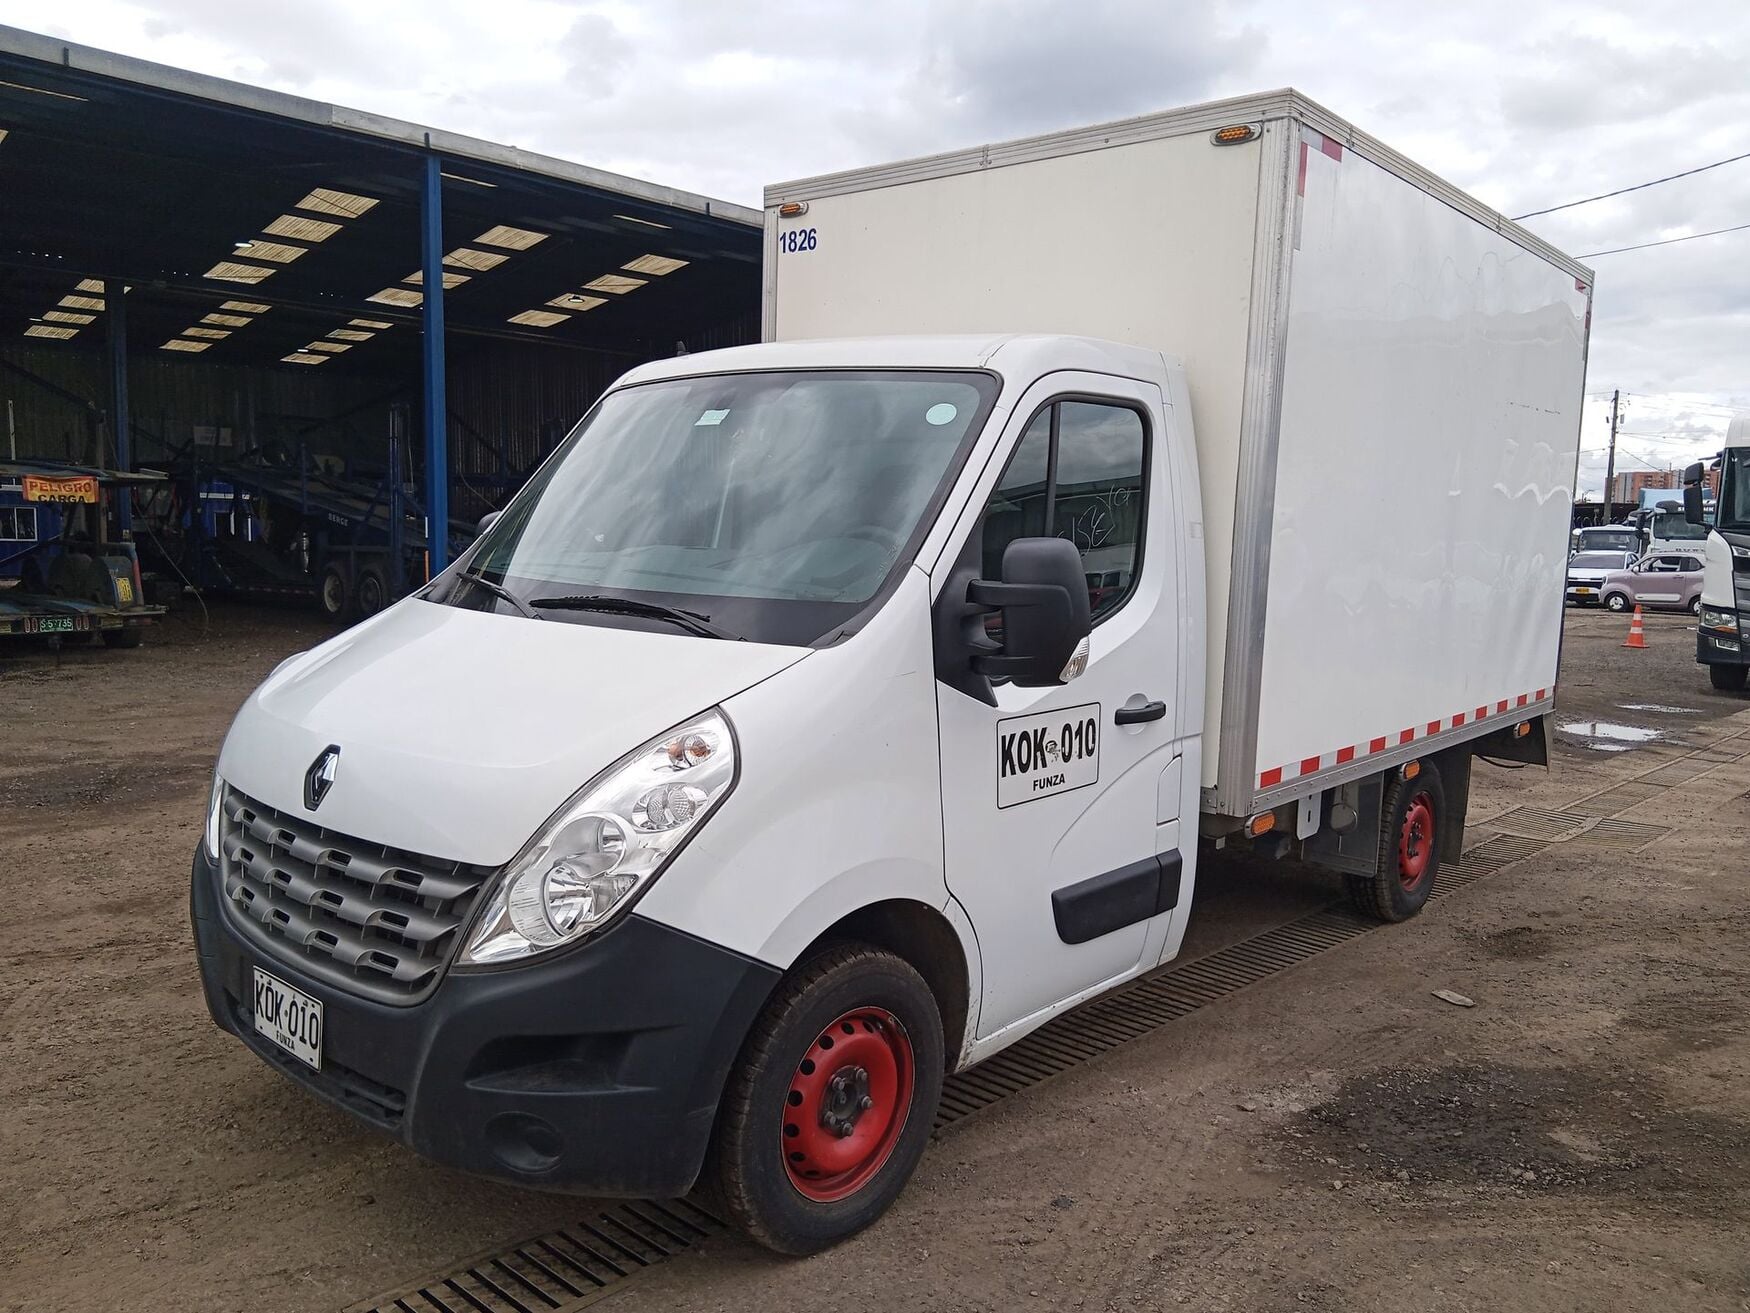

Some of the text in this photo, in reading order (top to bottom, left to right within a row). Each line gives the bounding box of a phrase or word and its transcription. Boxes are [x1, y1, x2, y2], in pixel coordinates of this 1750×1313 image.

[780, 228, 817, 254] 1826
[29, 480, 93, 493] PELIGRO
[38, 494, 87, 504] CARGA
[1033, 773, 1066, 791] FUNZA
[276, 1030, 296, 1051] FUNZA
